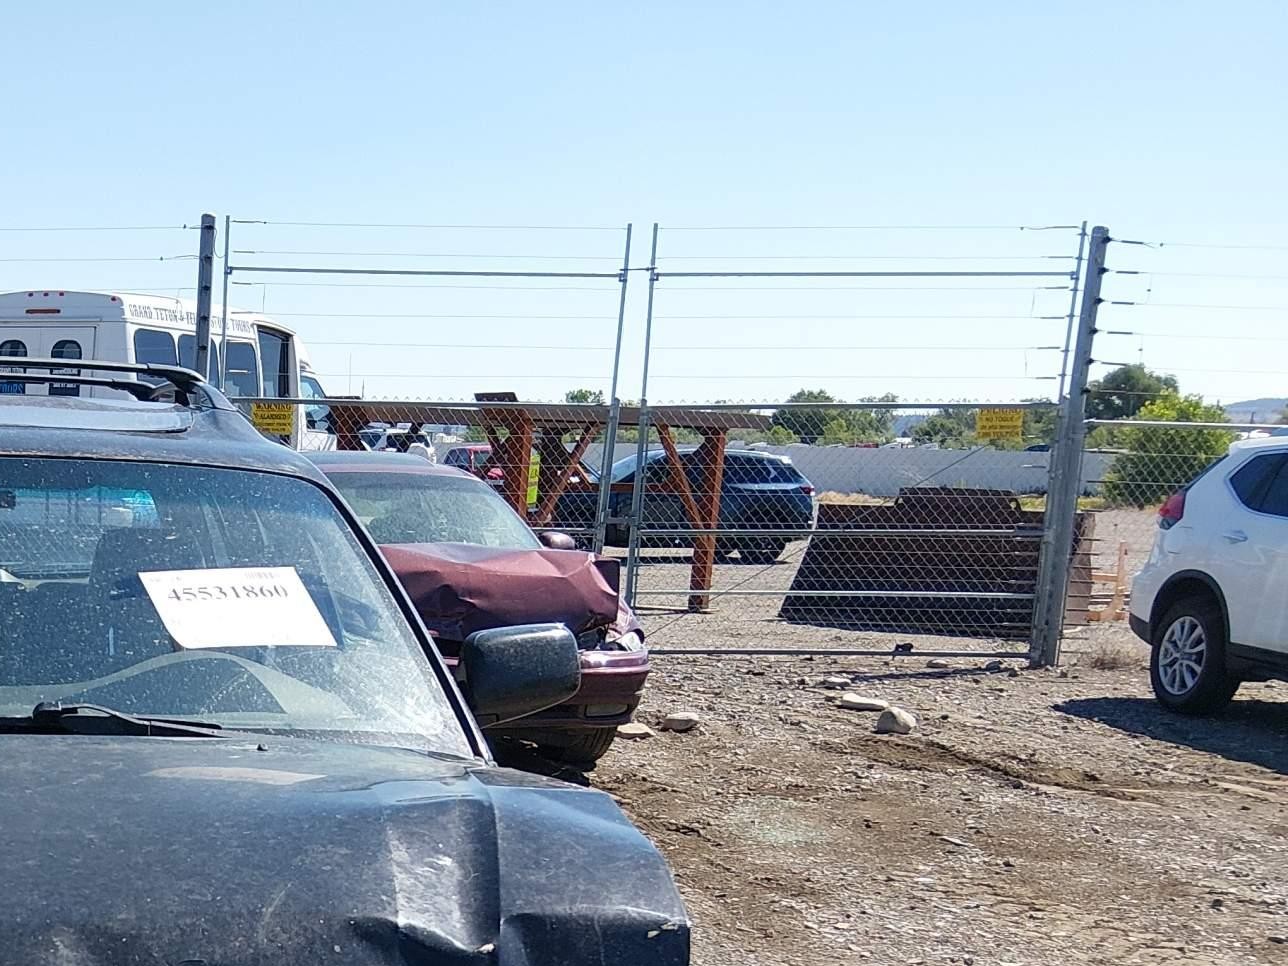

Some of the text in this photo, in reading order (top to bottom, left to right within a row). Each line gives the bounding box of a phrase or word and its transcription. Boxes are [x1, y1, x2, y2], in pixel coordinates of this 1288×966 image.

[129, 304, 152, 319] GRAND
[154, 308, 178, 323] TETON
[230, 319, 251, 332] TOURS
[168, 585, 289, 602] 45531860
